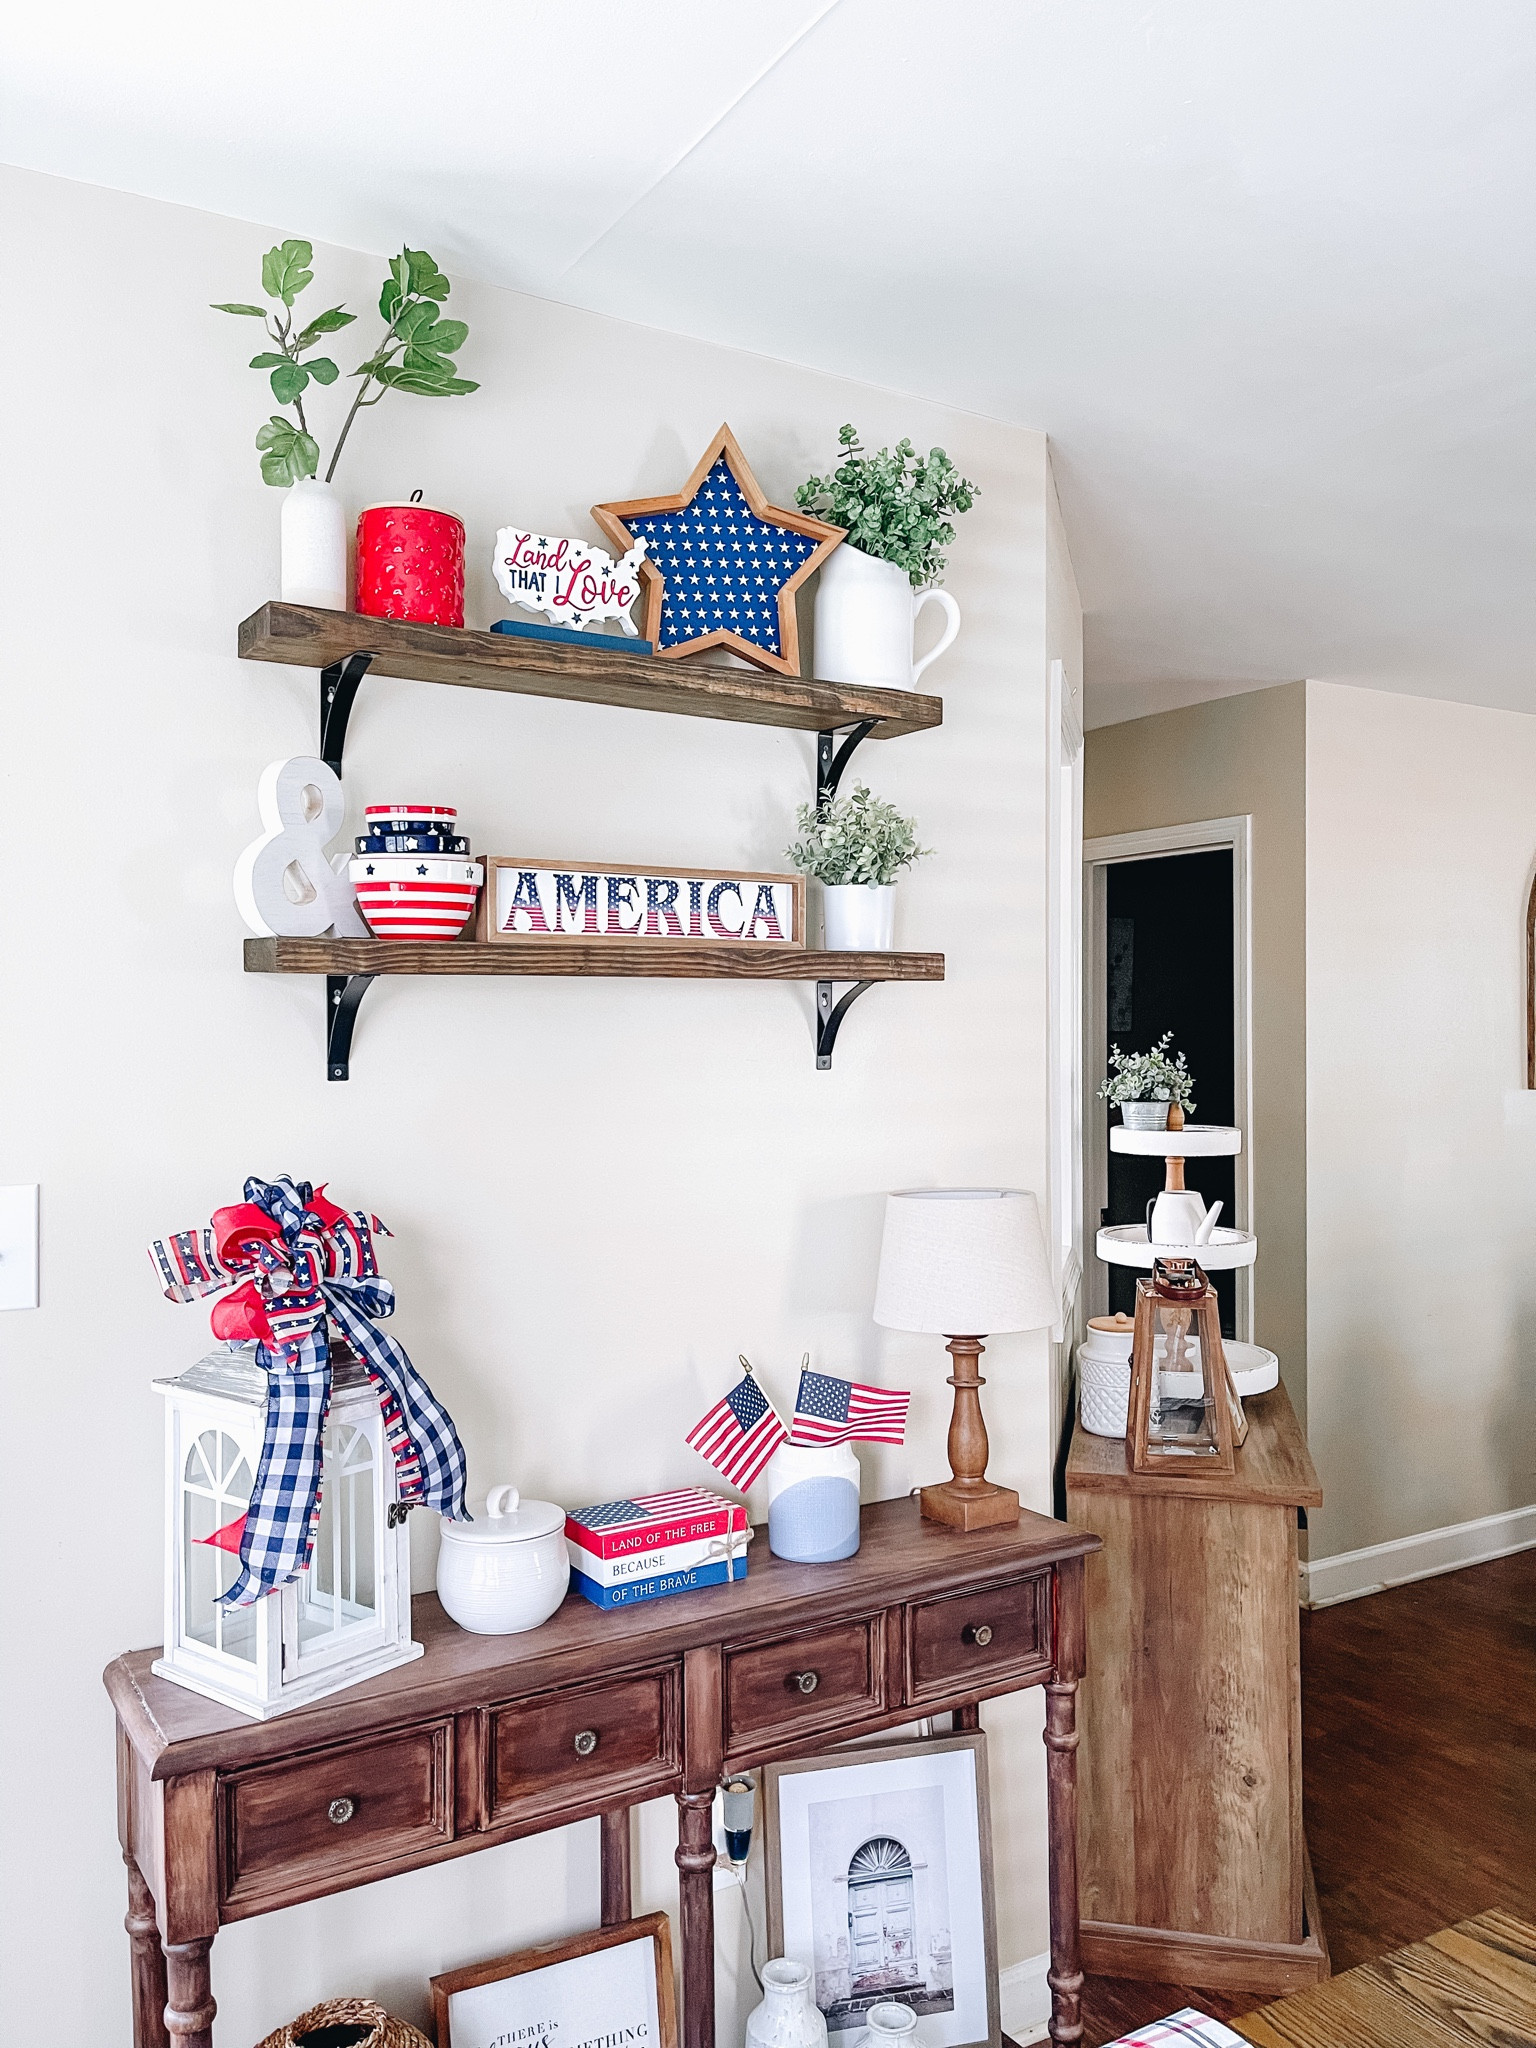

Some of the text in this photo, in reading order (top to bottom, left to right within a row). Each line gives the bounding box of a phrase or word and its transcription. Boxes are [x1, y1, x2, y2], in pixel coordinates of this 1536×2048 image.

[504, 533, 569, 572] Land
[509, 559, 634, 611] THAT I Love
[502, 872, 785, 940] AMERICA
[612, 1521, 716, 1552] LAND OF THE FREE
[612, 1555, 666, 1577] BECAUSE
[612, 1572, 697, 1602] OF THE BRAVE
[497, 2023, 546, 2046] THERE
[549, 2020, 559, 2031] is
